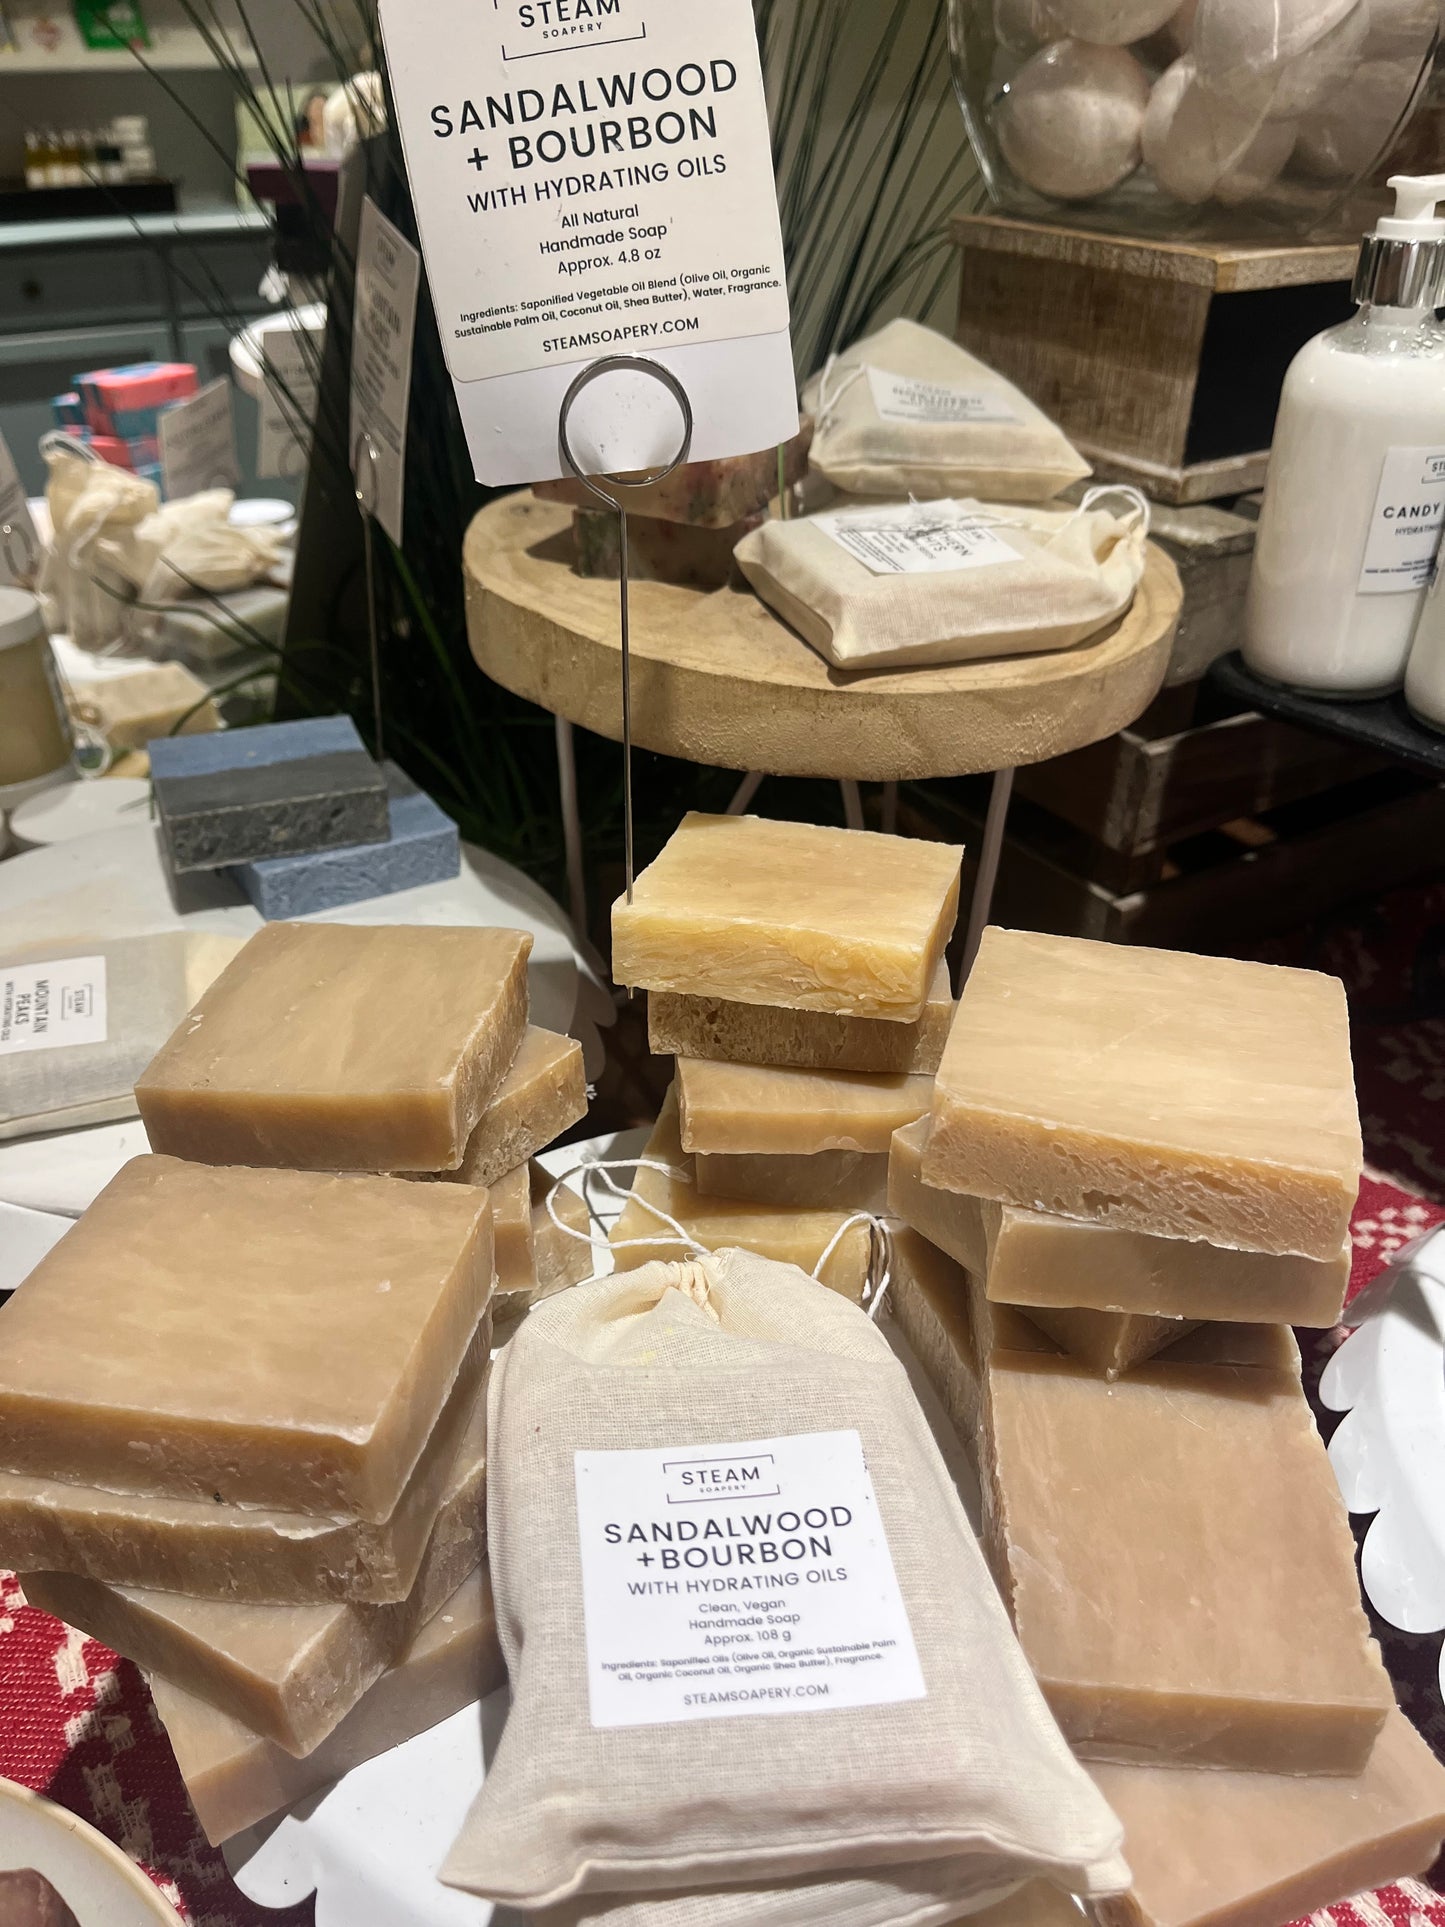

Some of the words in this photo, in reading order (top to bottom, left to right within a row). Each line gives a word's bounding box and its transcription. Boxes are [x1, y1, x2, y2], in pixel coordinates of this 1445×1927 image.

[518, 0, 621, 28] STEAM
[542, 21, 602, 39] SOAPERY
[430, 59, 737, 138] SANDALWOOD
[466, 147, 489, 172] +
[508, 106, 718, 170] BOURBON
[466, 184, 527, 214] WITH
[533, 162, 669, 202] HYDRATING
[676, 154, 727, 179] OILS
[560, 212, 580, 229] All
[582, 203, 640, 225] Natural
[539, 229, 625, 255] Handmade
[628, 223, 668, 240] Soap
[557, 255, 614, 277] Approx.
[617, 248, 640, 264] 4.8
[644, 247, 662, 261] oz
[460, 304, 519, 323] Ingredients:
[520, 292, 574, 311] Saponified
[576, 284, 629, 302] Vegetable
[631, 281, 646, 292] Oil
[648, 277, 677, 289] Blend
[679, 272, 710, 287] (Olive
[712, 270, 728, 281] Oil,
[730, 264, 771, 279] Organic
[454, 319, 512, 339] Sustainable
[513, 315, 540, 327] Palm
[541, 310, 559, 322] Oil,
[559, 302, 603, 319] Coconut
[605, 299, 622, 311] Oil,
[624, 297, 650, 309] Shea
[652, 288, 691, 304] Butter),
[692, 286, 726, 299] Water,
[727, 279, 782, 294] Fragrance.
[542, 316, 699, 353] STEAMSOAPERY.COM
[1382, 502, 1441, 519] CANDY
[14, 992, 31, 1025] PEAKS
[32, 979, 49, 1034] MOUNTAIN
[681, 1465, 761, 1486] STEAM
[699, 1484, 746, 1494] SOAPERY
[603, 1505, 853, 1545] SANDALWOOD
[635, 1534, 833, 1570] +BOURBON
[627, 1580, 680, 1596] WITH
[685, 1571, 800, 1594] HYDRATING
[805, 1567, 848, 1584] OILS
[688, 1615, 764, 1630] Handmade
[766, 1611, 801, 1626] Soap
[698, 1601, 741, 1614] Clean,
[742, 1598, 786, 1613] Vegan
[704, 1631, 754, 1648] Approx.
[756, 1628, 779, 1642] 108
[782, 1629, 793, 1643] g
[601, 1659, 658, 1671] Ingredients:
[660, 1656, 710, 1668] Saponified
[711, 1654, 730, 1664] Oils
[731, 1652, 759, 1663] (Olive
[761, 1650, 777, 1660] Oil,
[778, 1647, 815, 1659] Organic
[816, 1640, 870, 1655] Sustainable
[872, 1638, 897, 1648] Palm
[618, 1672, 634, 1682] Oil,
[635, 1670, 673, 1682] Organic
[675, 1667, 715, 1678] Coconut
[716, 1665, 732, 1675] Oil,
[733, 1661, 771, 1674] Organic
[773, 1660, 796, 1670] Shea
[798, 1656, 833, 1668] Butter),
[834, 1652, 884, 1665] Fragrance.
[683, 1682, 830, 1706] STEAMSOAPERY.COM
